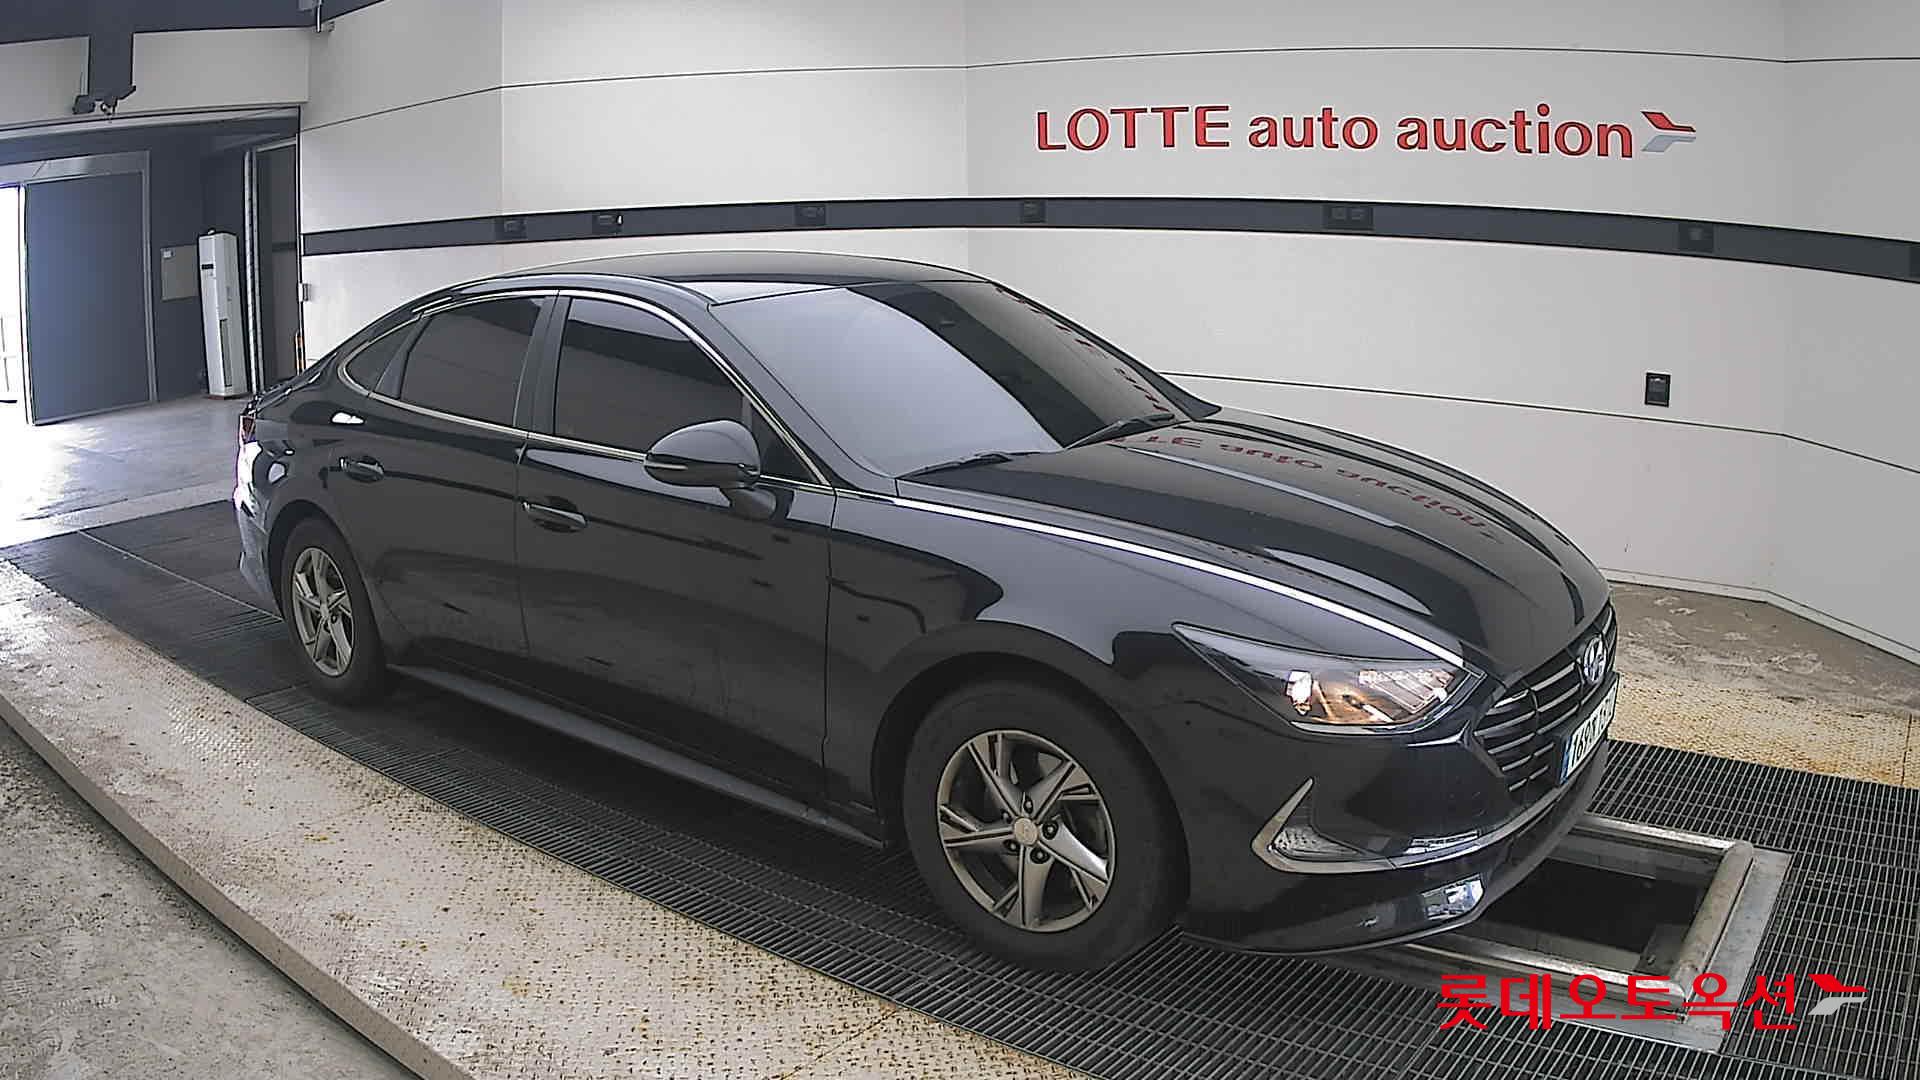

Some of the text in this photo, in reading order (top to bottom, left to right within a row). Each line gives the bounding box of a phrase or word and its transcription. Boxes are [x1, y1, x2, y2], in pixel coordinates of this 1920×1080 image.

[1037, 103, 1634, 158] LOTTE auto auction
